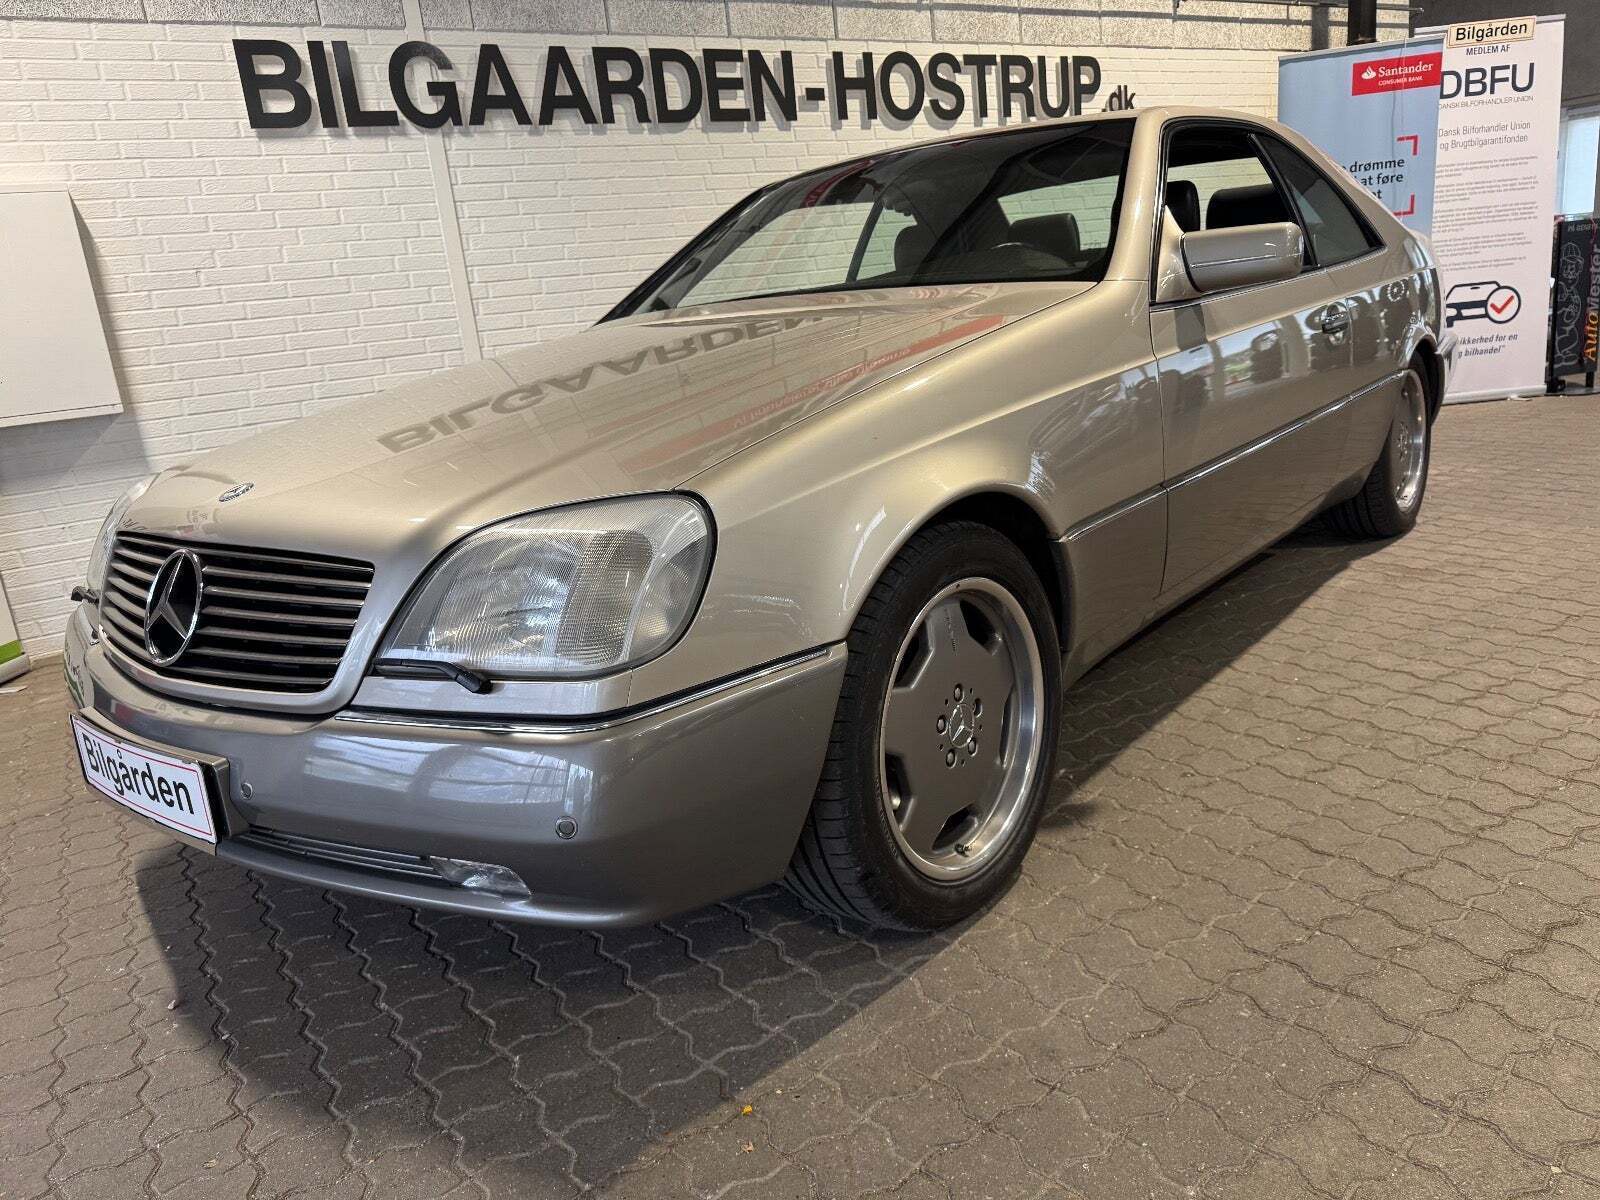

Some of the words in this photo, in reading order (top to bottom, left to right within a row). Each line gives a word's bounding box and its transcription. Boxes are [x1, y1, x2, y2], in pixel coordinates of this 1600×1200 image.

[1455, 22, 1527, 41] Bilgården
[1466, 45, 1498, 56] MEDLEM
[1500, 44, 1511, 52] AF
[1378, 61, 1433, 77] Santander
[1378, 78, 1407, 86] CONSUMER
[1440, 62, 1534, 99] DBFU
[1461, 97, 1512, 108] BILFORHANDLER
[1513, 95, 1533, 103] UNION
[1439, 126, 1460, 137] Dansk
[1463, 122, 1508, 135] Bilforhandler
[1510, 120, 1531, 131] Union
[1440, 142, 1449, 151] og
[1451, 135, 1528, 150] Brugtbilgarantifonden
[1350, 159, 1405, 173] drømme
[1377, 172, 1404, 185] føre
[1495, 333, 1506, 342] for
[1508, 333, 1519, 341] en
[82, 733, 194, 814] Bilgården
